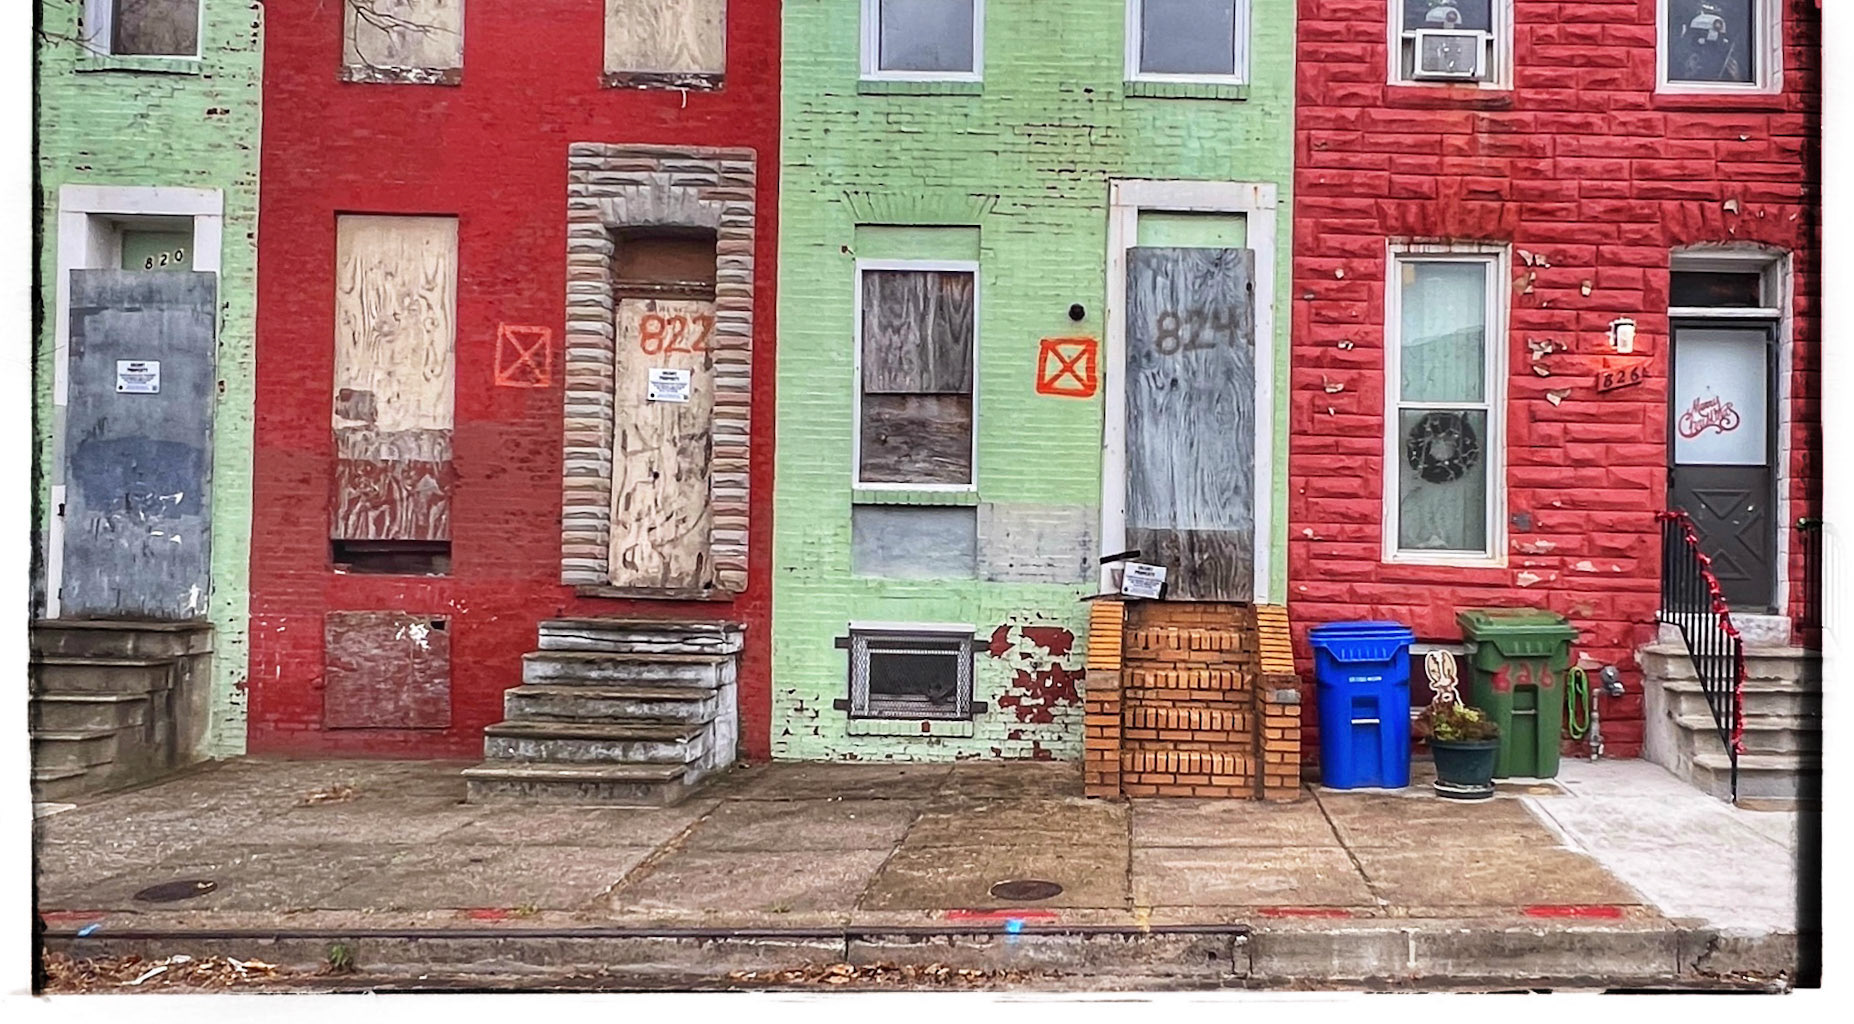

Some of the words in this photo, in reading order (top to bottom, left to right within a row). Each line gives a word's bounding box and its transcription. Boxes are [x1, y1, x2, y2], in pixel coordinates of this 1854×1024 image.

[145, 249, 183, 270] 820
[640, 313, 714, 355] 822
[1157, 305, 1239, 355] 824
[1603, 366, 1640, 388] 826
[1491, 661, 1555, 693] 826
